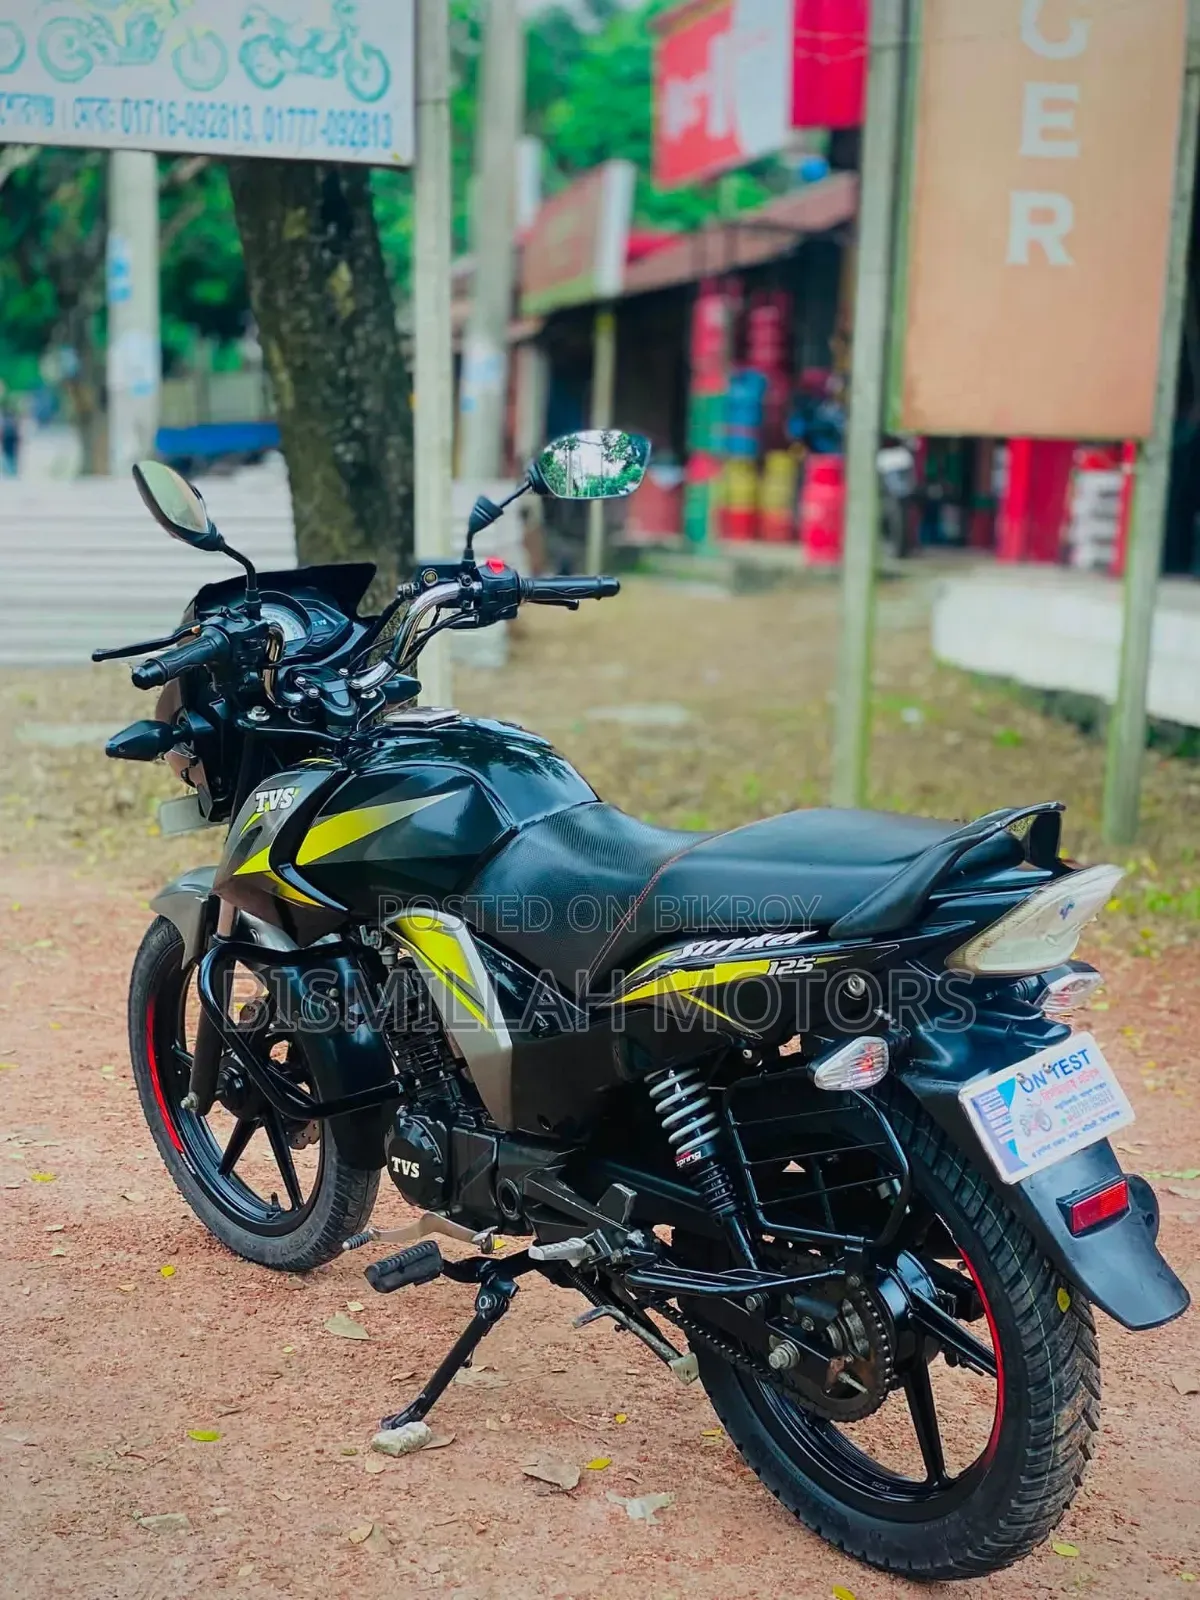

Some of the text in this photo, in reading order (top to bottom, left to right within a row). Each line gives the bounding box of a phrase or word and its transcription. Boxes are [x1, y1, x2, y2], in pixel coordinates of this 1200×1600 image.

[256, 787, 295, 813] TVS
[767, 958, 816, 976] 125
[1018, 1070, 1048, 1094] ON
[1049, 1048, 1090, 1079] TEST
[391, 1156, 420, 1178] TVS
